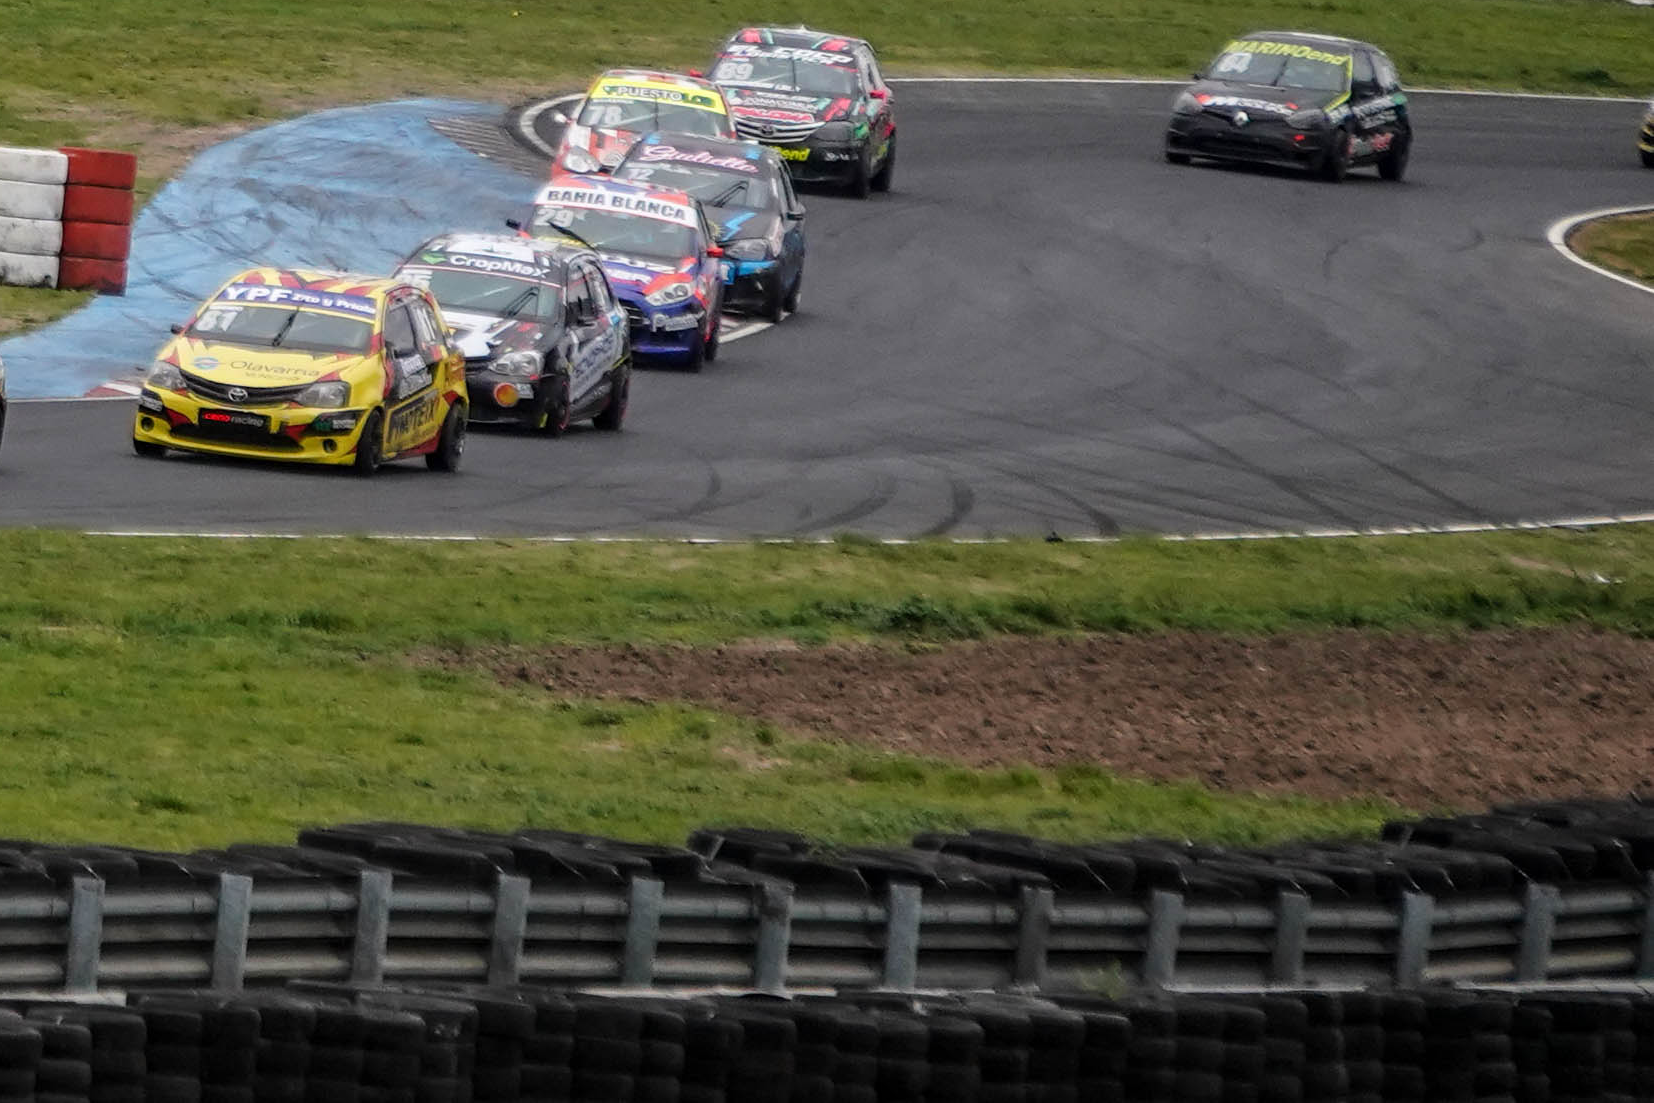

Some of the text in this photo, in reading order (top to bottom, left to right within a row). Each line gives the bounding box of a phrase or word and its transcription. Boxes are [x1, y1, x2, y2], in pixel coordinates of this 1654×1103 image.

[617, 86, 683, 102] PUESTO
[547, 190, 687, 221] BAHIA BLANCA
[449, 254, 551, 278] CropMax
[225, 285, 294, 303] YPF
